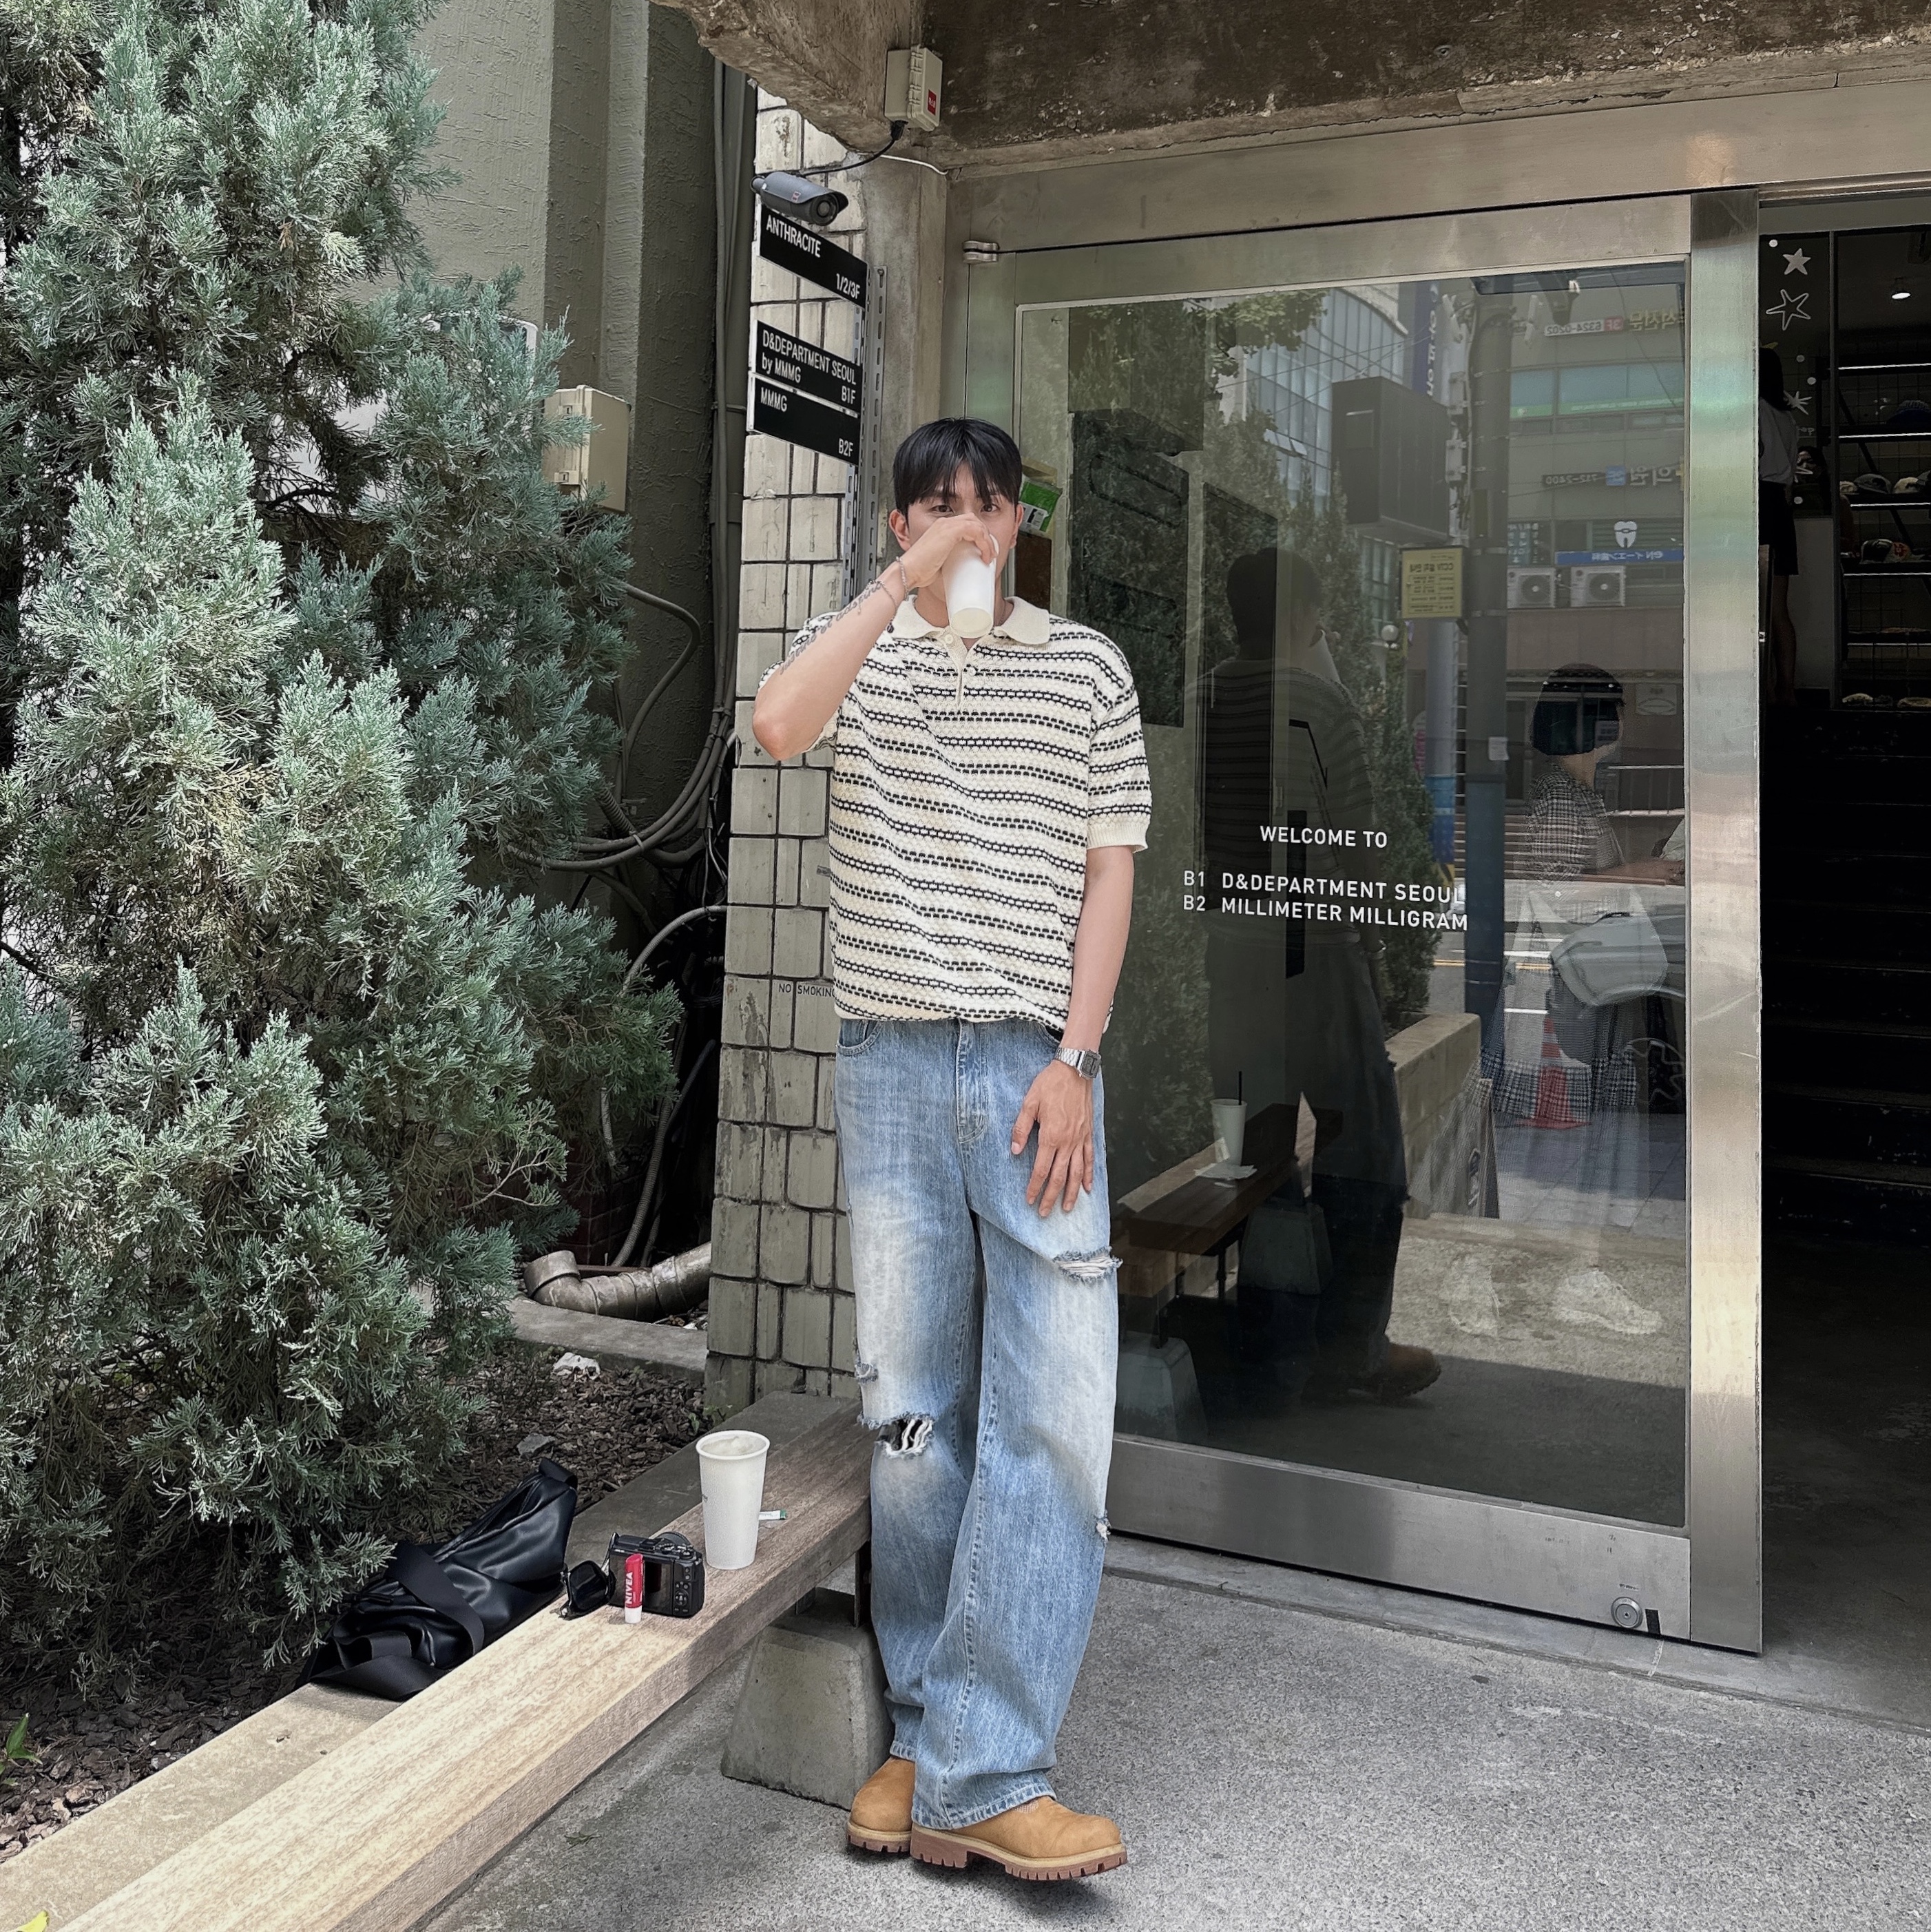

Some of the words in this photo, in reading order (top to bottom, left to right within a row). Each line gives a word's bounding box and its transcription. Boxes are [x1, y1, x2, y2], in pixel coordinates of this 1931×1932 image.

[766, 214, 822, 258] ANTHRACITE
[835, 273, 860, 300] 1/2/3F
[761, 352, 772, 375] by
[774, 360, 802, 384] MMMG
[762, 329, 831, 372] D&DEPARTMENT
[831, 358, 857, 385] SEOUL
[760, 387, 788, 412] MMMG
[841, 385, 856, 404] B1F
[838, 437, 854, 457] B2F
[1260, 825, 1357, 847] WELCOME
[1362, 831, 1388, 849] TO
[1183, 870, 1205, 888] B1
[1222, 872, 1387, 900] D&DEPARTMENT
[1394, 883, 1466, 905] SEOUL
[1182, 895, 1206, 912] B2
[1221, 897, 1342, 922] MILLIMETER
[1349, 906, 1468, 931] MILLIGRAM
[778, 983, 792, 993] NO
[625, 1571, 634, 1605] NIVEA
